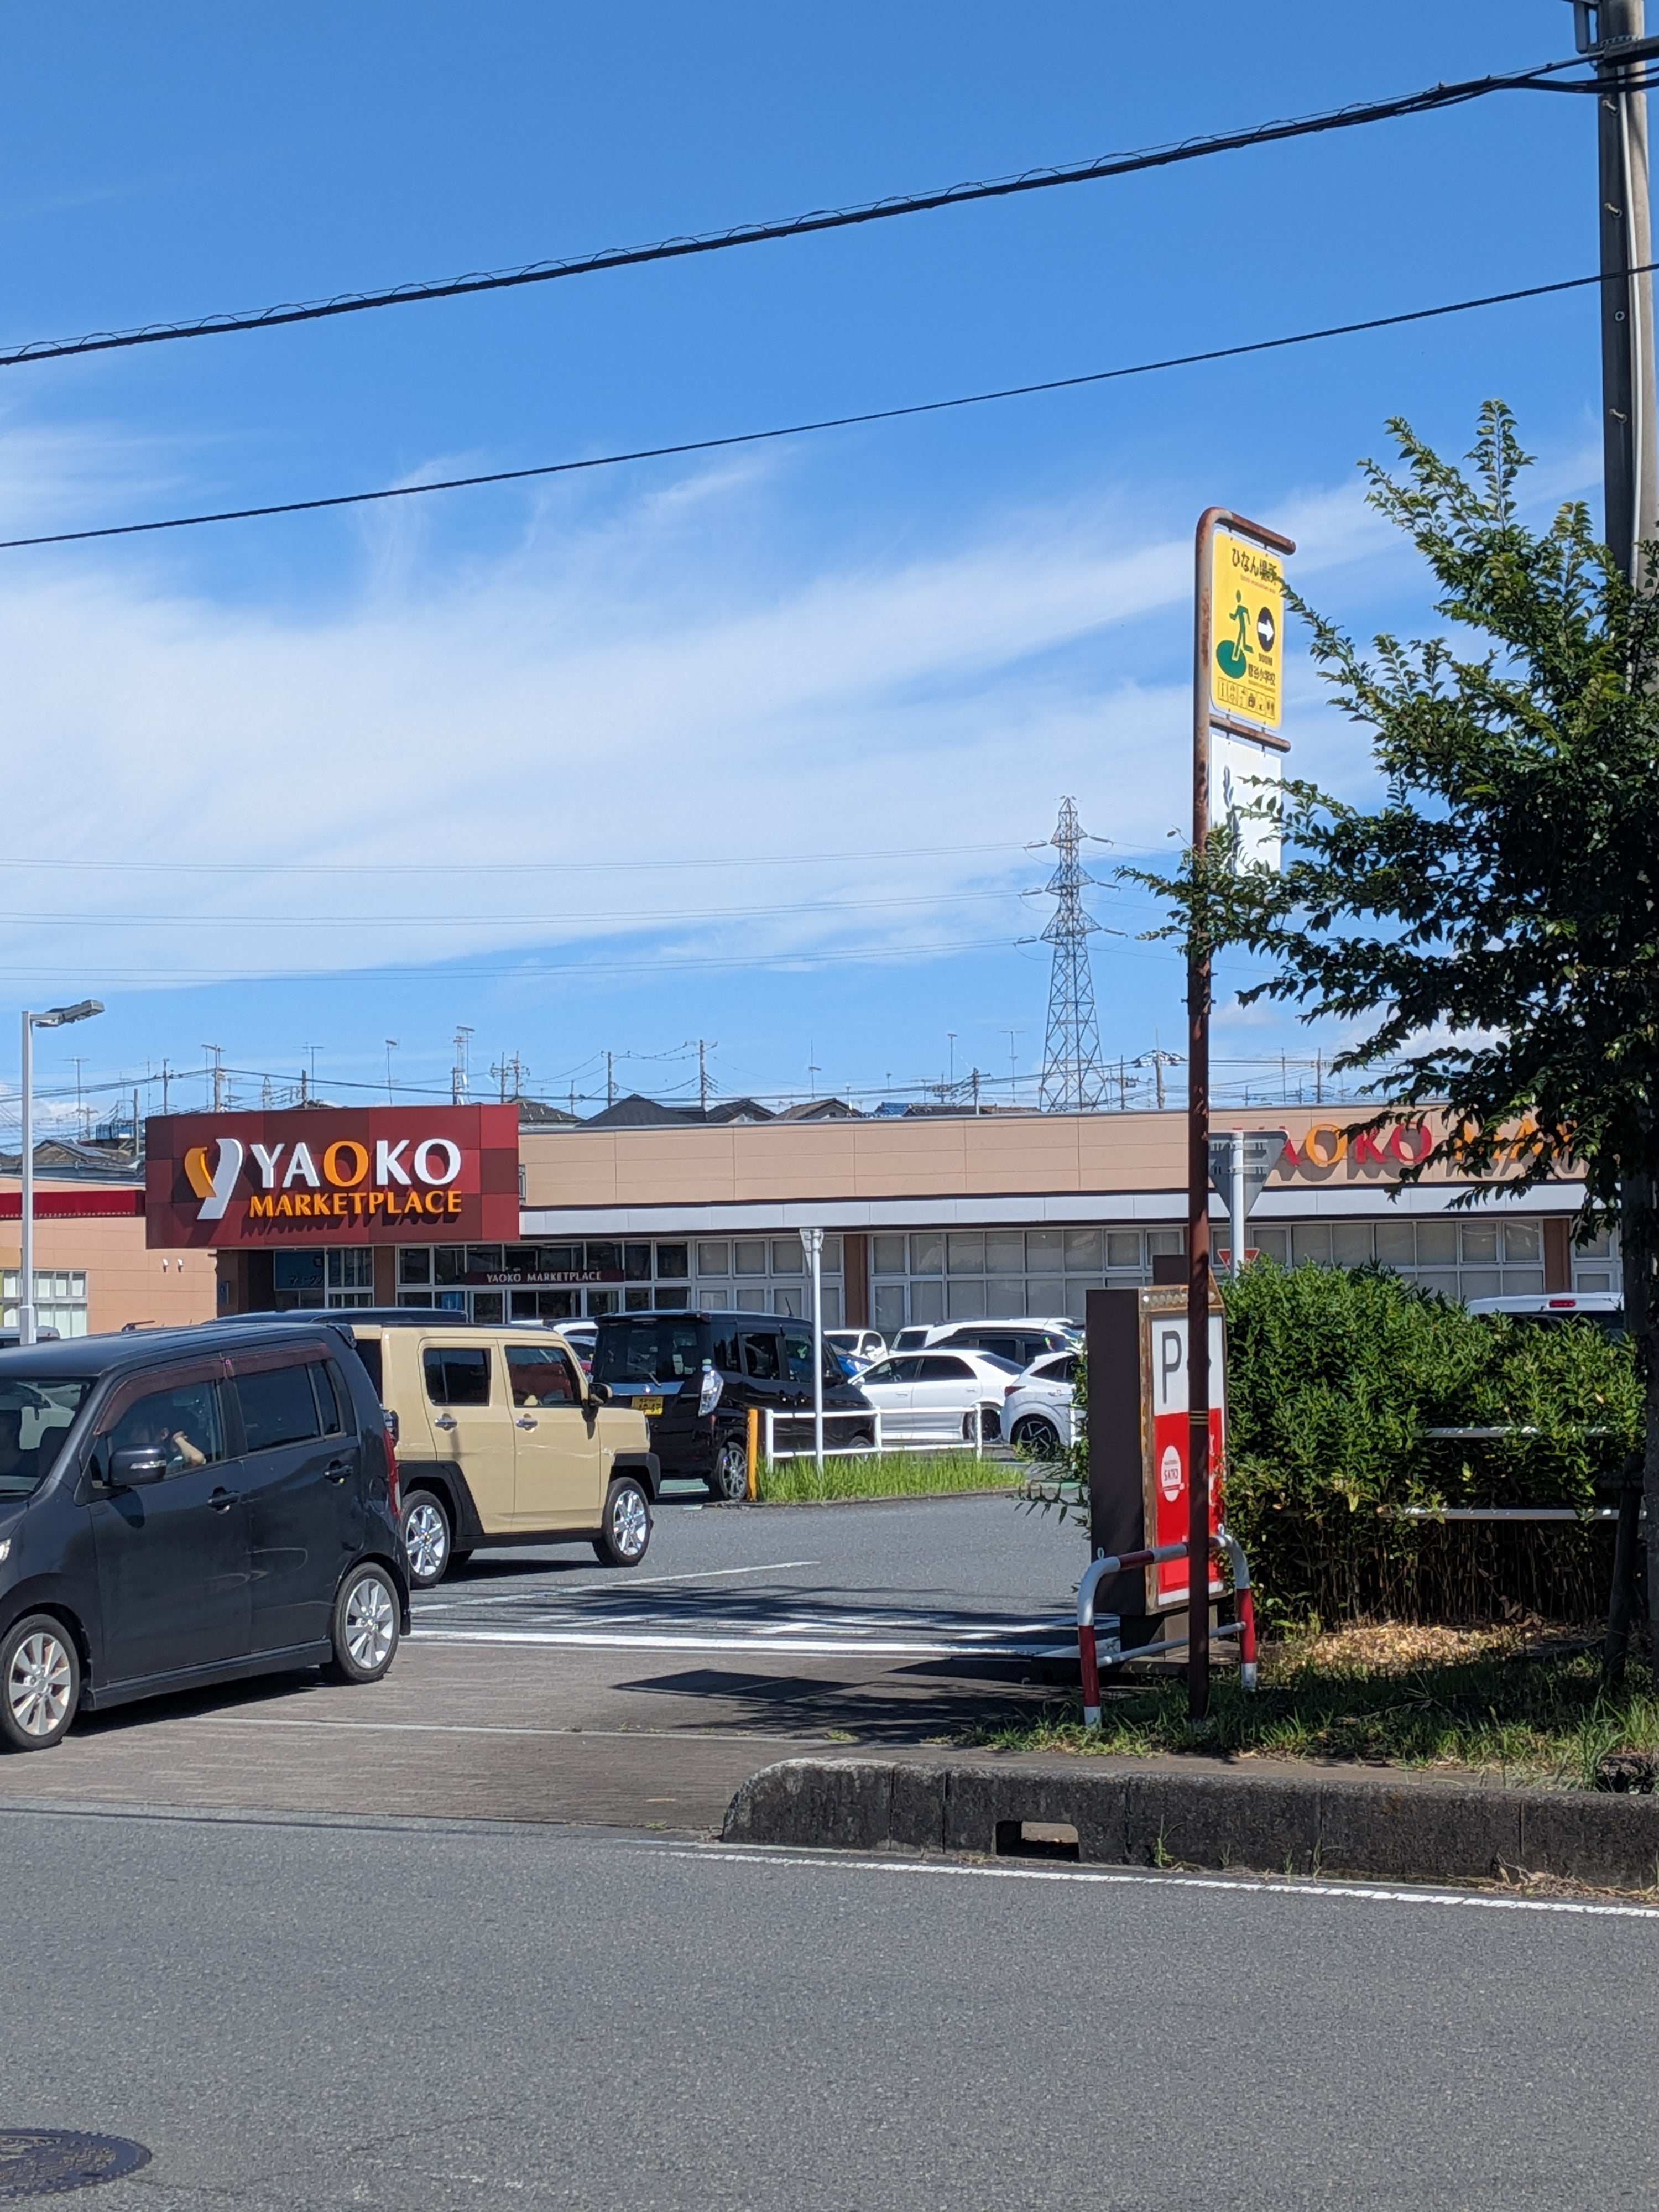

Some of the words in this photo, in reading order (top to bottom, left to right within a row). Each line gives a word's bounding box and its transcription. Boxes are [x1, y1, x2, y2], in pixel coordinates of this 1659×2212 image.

[249, 1138, 461, 1188] YAOKO
[249, 1190, 462, 1217] MARKETPLACE
[487, 1273, 521, 1283] YAOKO
[527, 1271, 601, 1282] MARKETPLACE
[1162, 1331, 1182, 1404] P
